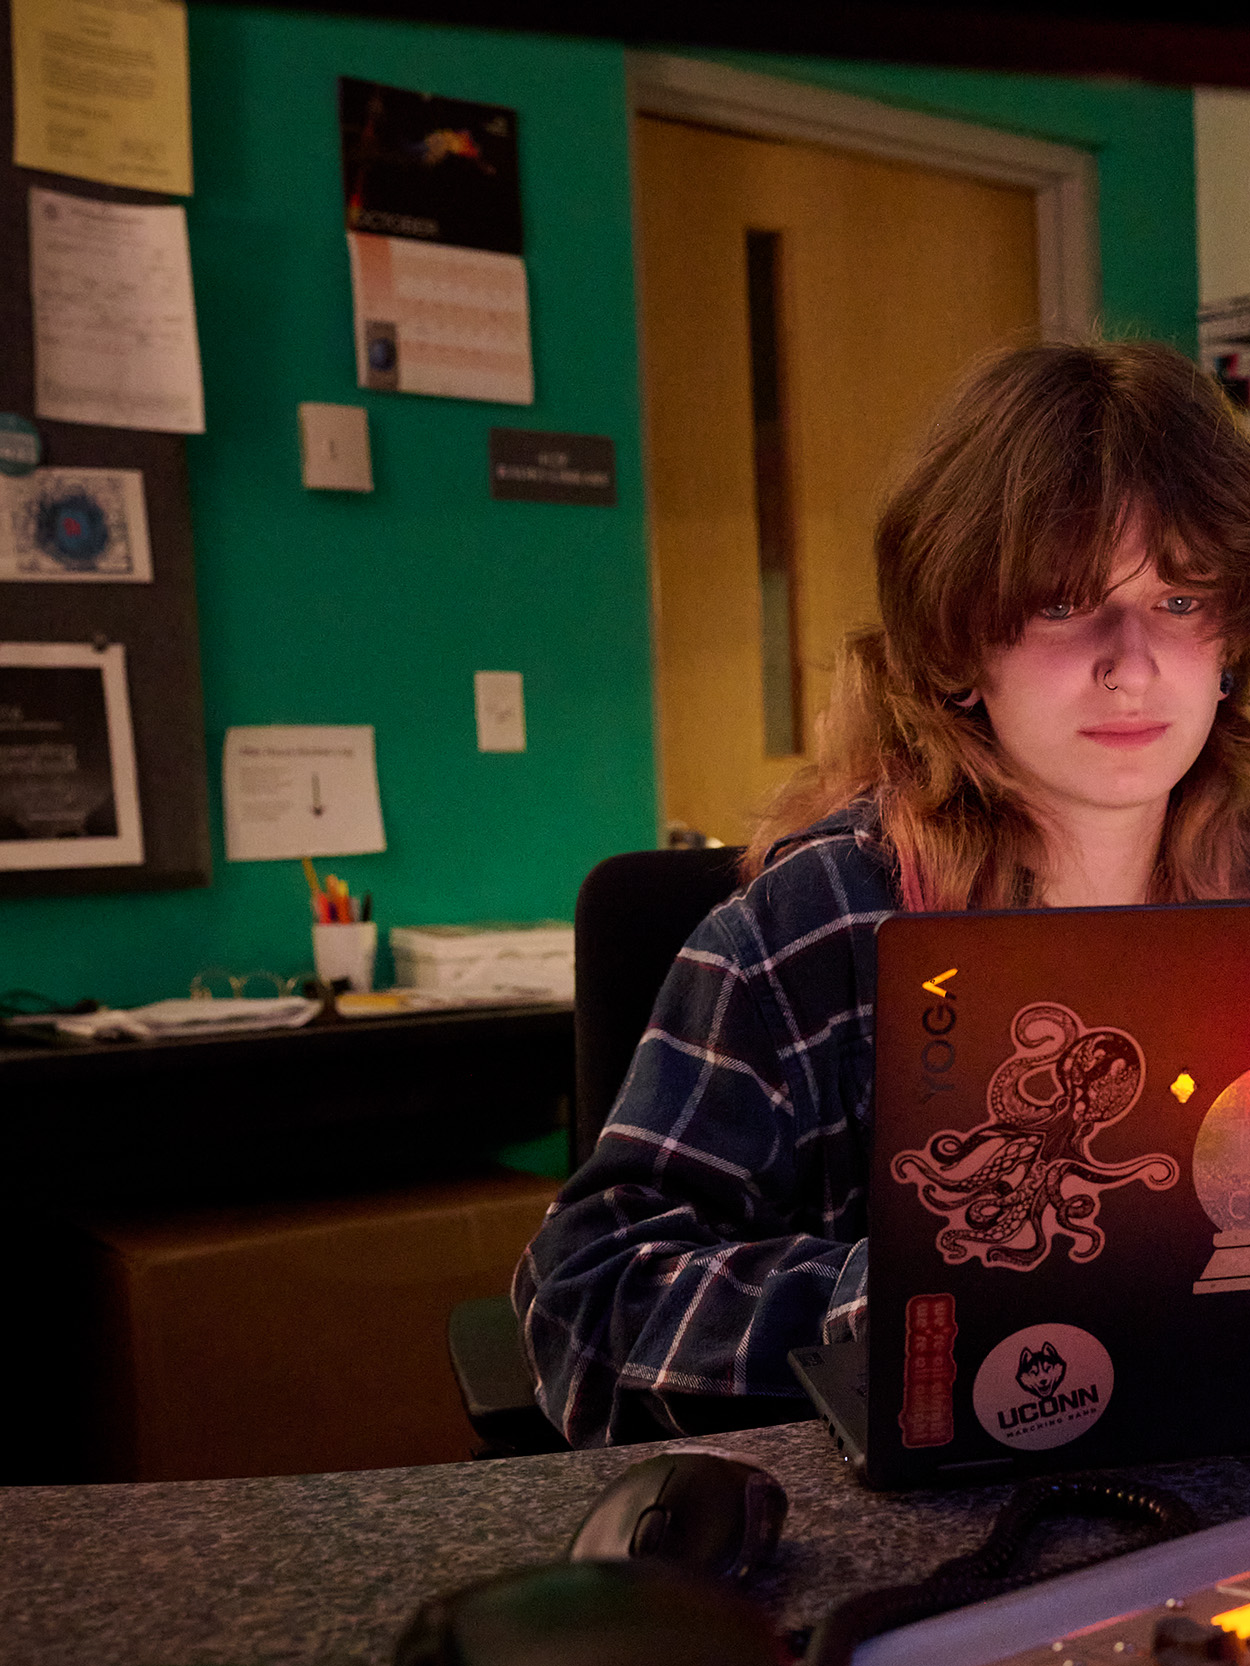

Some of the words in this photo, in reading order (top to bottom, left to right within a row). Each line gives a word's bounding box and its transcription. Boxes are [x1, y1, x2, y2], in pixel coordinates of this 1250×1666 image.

[919, 967, 959, 1106] YOGA
[997, 1384, 1100, 1430] UCONN
[1006, 1418, 1063, 1438] MARCHING
[1068, 1407, 1097, 1421] BAND
